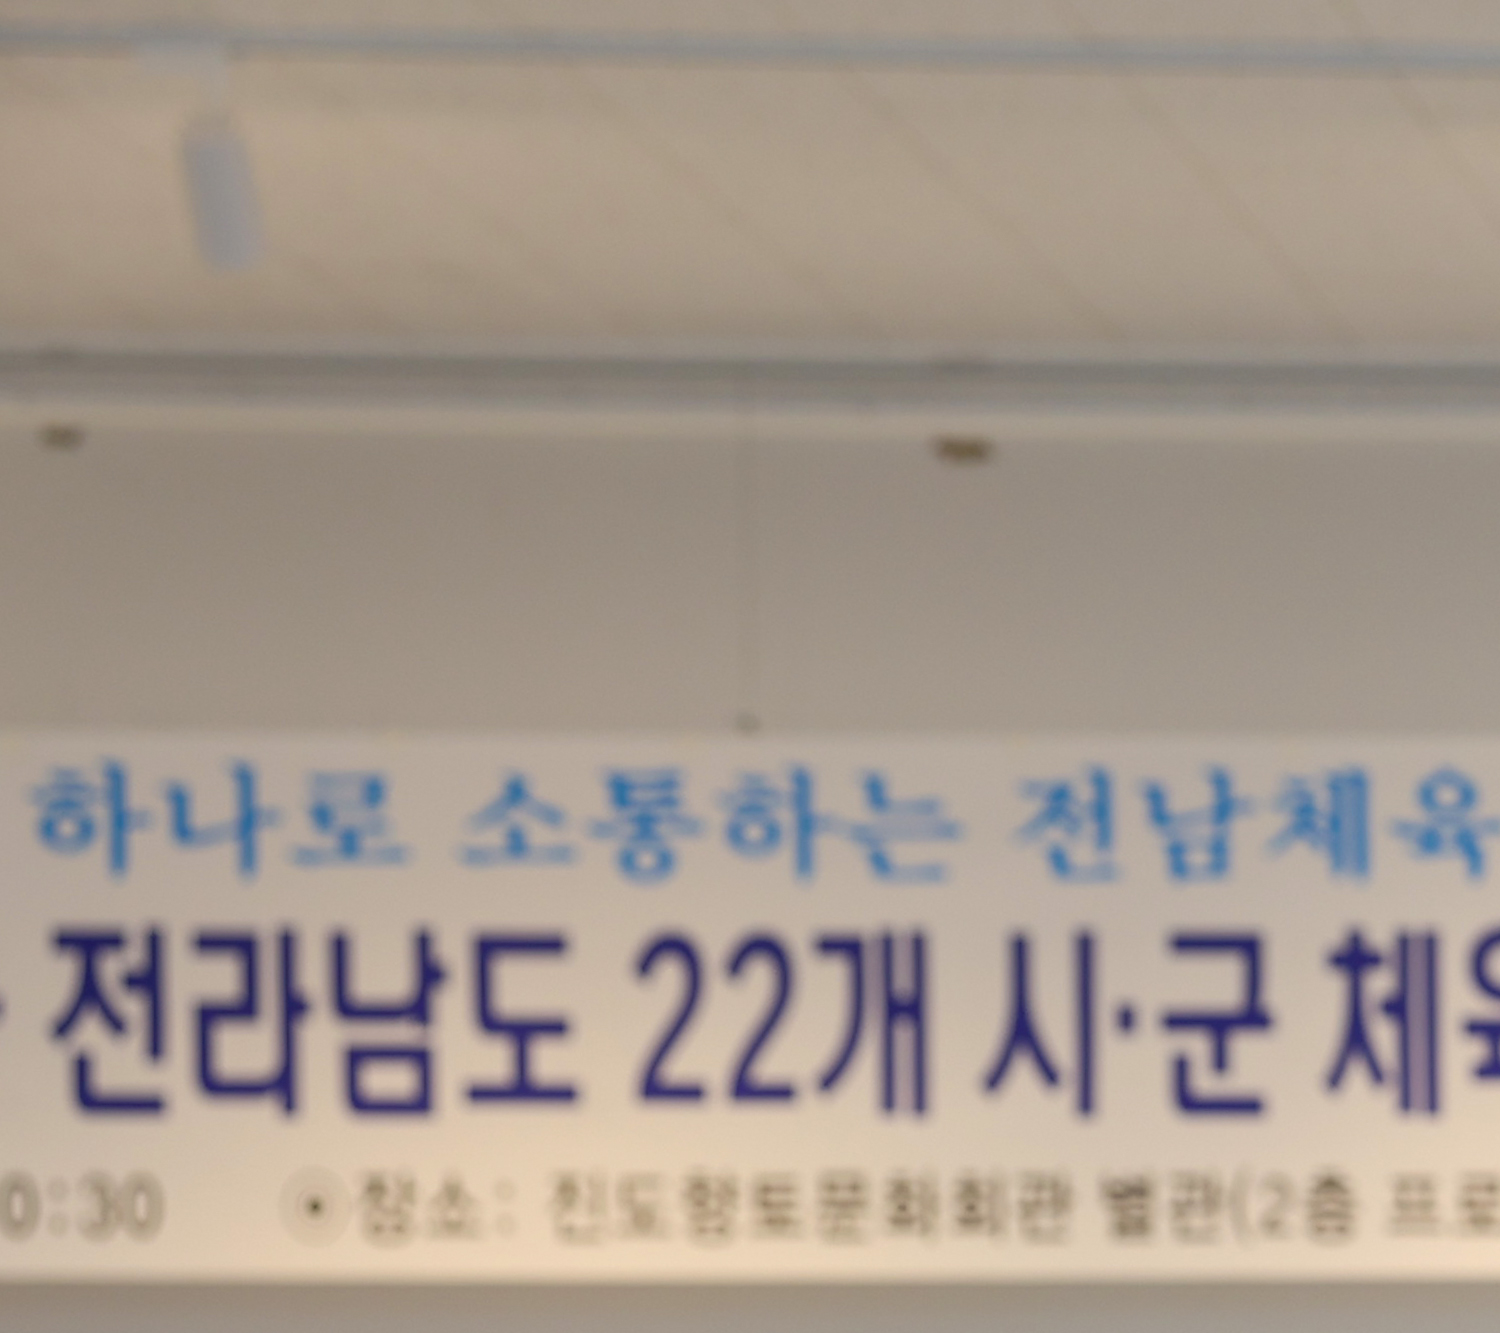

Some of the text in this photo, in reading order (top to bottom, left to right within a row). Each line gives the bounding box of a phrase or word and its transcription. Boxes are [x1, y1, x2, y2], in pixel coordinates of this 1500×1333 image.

[28, 760, 408, 878] 하나로
[459, 764, 962, 884] 소통하는
[50, 926, 577, 1118] 전라남도
[634, 930, 927, 1117] 22개
[984, 928, 1273, 1116] 시·군
[553, 1170, 1071, 1246] 진도향토문화회관
